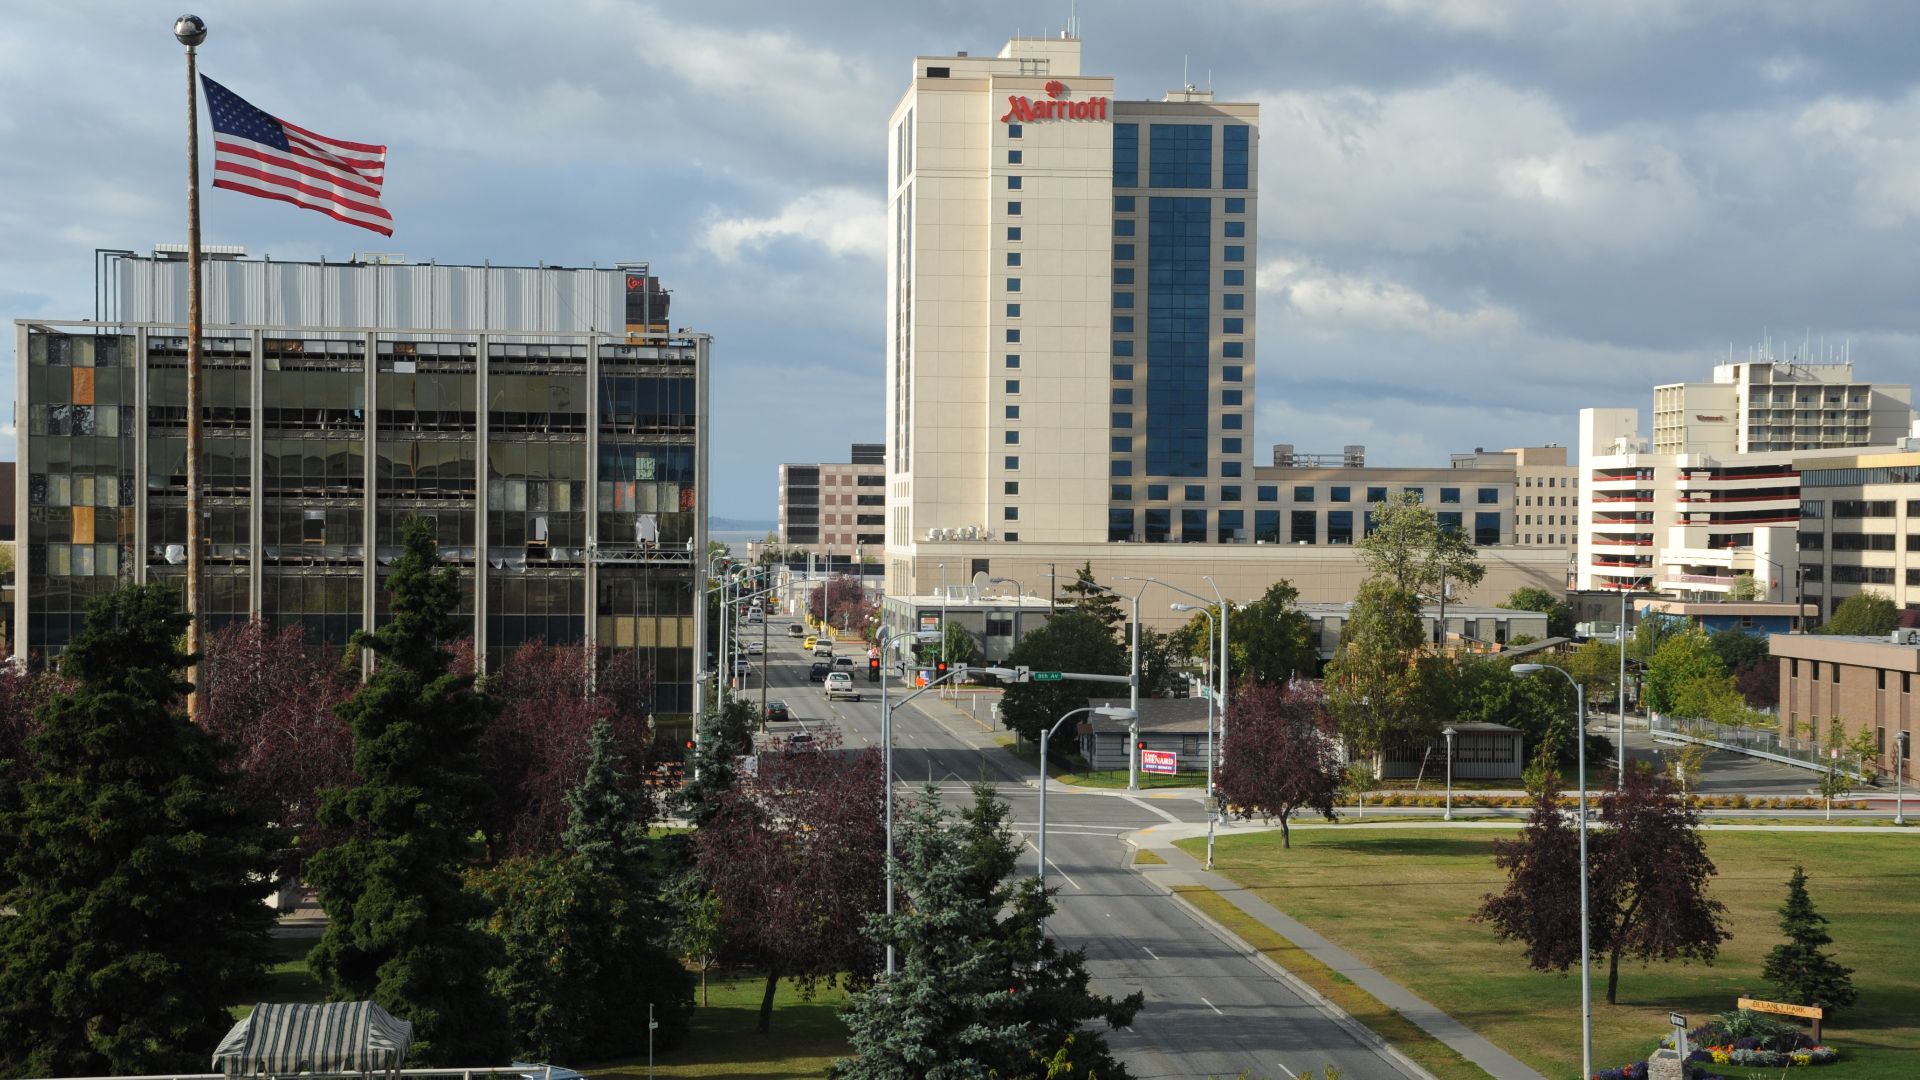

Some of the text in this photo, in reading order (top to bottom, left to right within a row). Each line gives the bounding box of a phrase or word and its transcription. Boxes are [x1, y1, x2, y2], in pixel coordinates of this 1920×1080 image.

[1000, 95, 1106, 123] Marriott
[1144, 756, 1174, 766] MENARD
[1753, 1001, 1785, 1011] DELANEY
[1786, 1005, 1806, 1013] PARK
